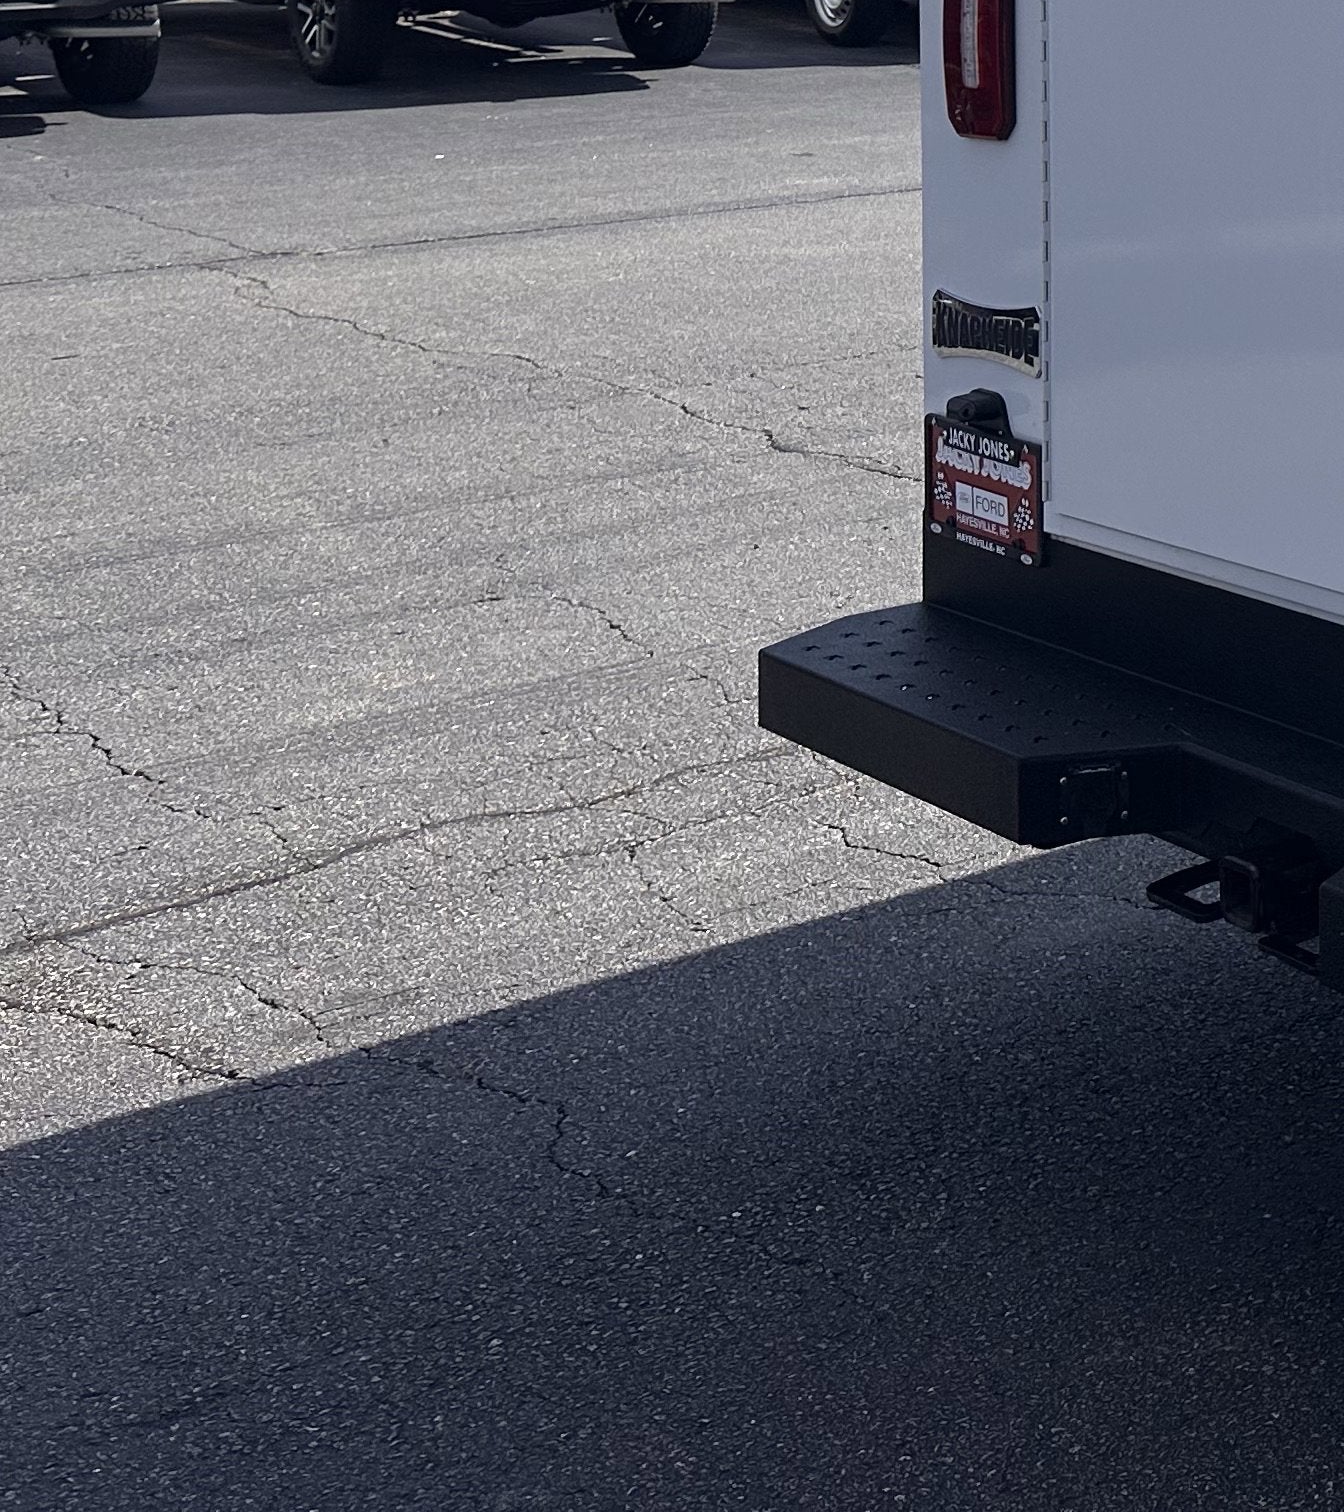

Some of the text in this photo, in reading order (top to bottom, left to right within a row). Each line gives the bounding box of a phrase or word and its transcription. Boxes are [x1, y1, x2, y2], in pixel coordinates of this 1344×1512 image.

[933, 299, 1039, 368] KNAPHEIDE
[948, 426, 1009, 462] JACKY JONES
[975, 495, 1006, 518] FORD
